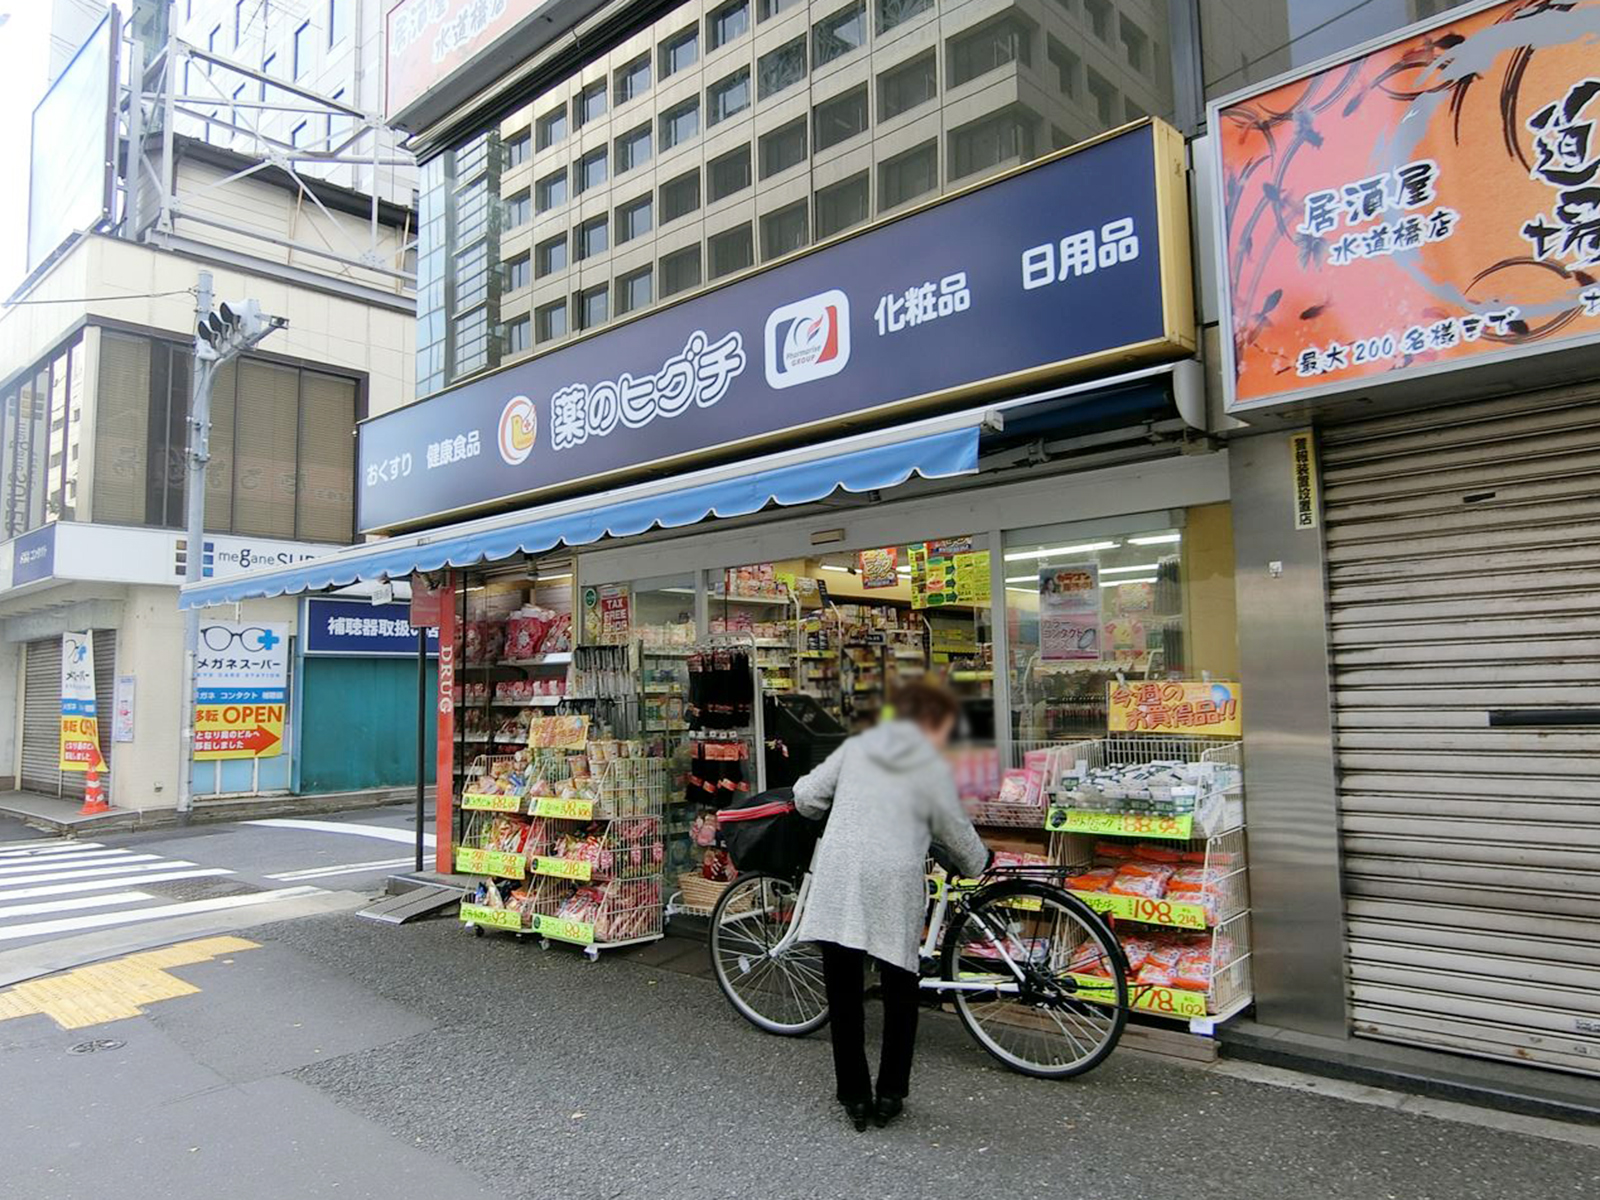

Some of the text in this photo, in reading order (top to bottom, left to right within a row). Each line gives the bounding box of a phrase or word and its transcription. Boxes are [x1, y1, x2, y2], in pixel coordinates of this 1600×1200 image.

[1303, 162, 1437, 233] 居酒屋
[1330, 210, 1457, 264] 水道橋店
[1022, 217, 1139, 290] 日用品
[874, 271, 971, 336] 化粧品
[551, 330, 746, 450] 薬のヒグチ
[426, 430, 481, 470] 健康食品
[366, 452, 413, 487] おくすり
[219, 549, 275, 568] megane
[604, 609, 627, 621] FREE
[606, 599, 623, 609] TAX
[197, 658, 281, 670] メガネスーパー
[439, 645, 453, 714] DRUG
[220, 691, 258, 700] コンタクト
[1112, 683, 1184, 707] 今週の
[222, 705, 283, 724] OPEN
[1134, 899, 1171, 924] 198
[1181, 1003, 1203, 1015] 192
